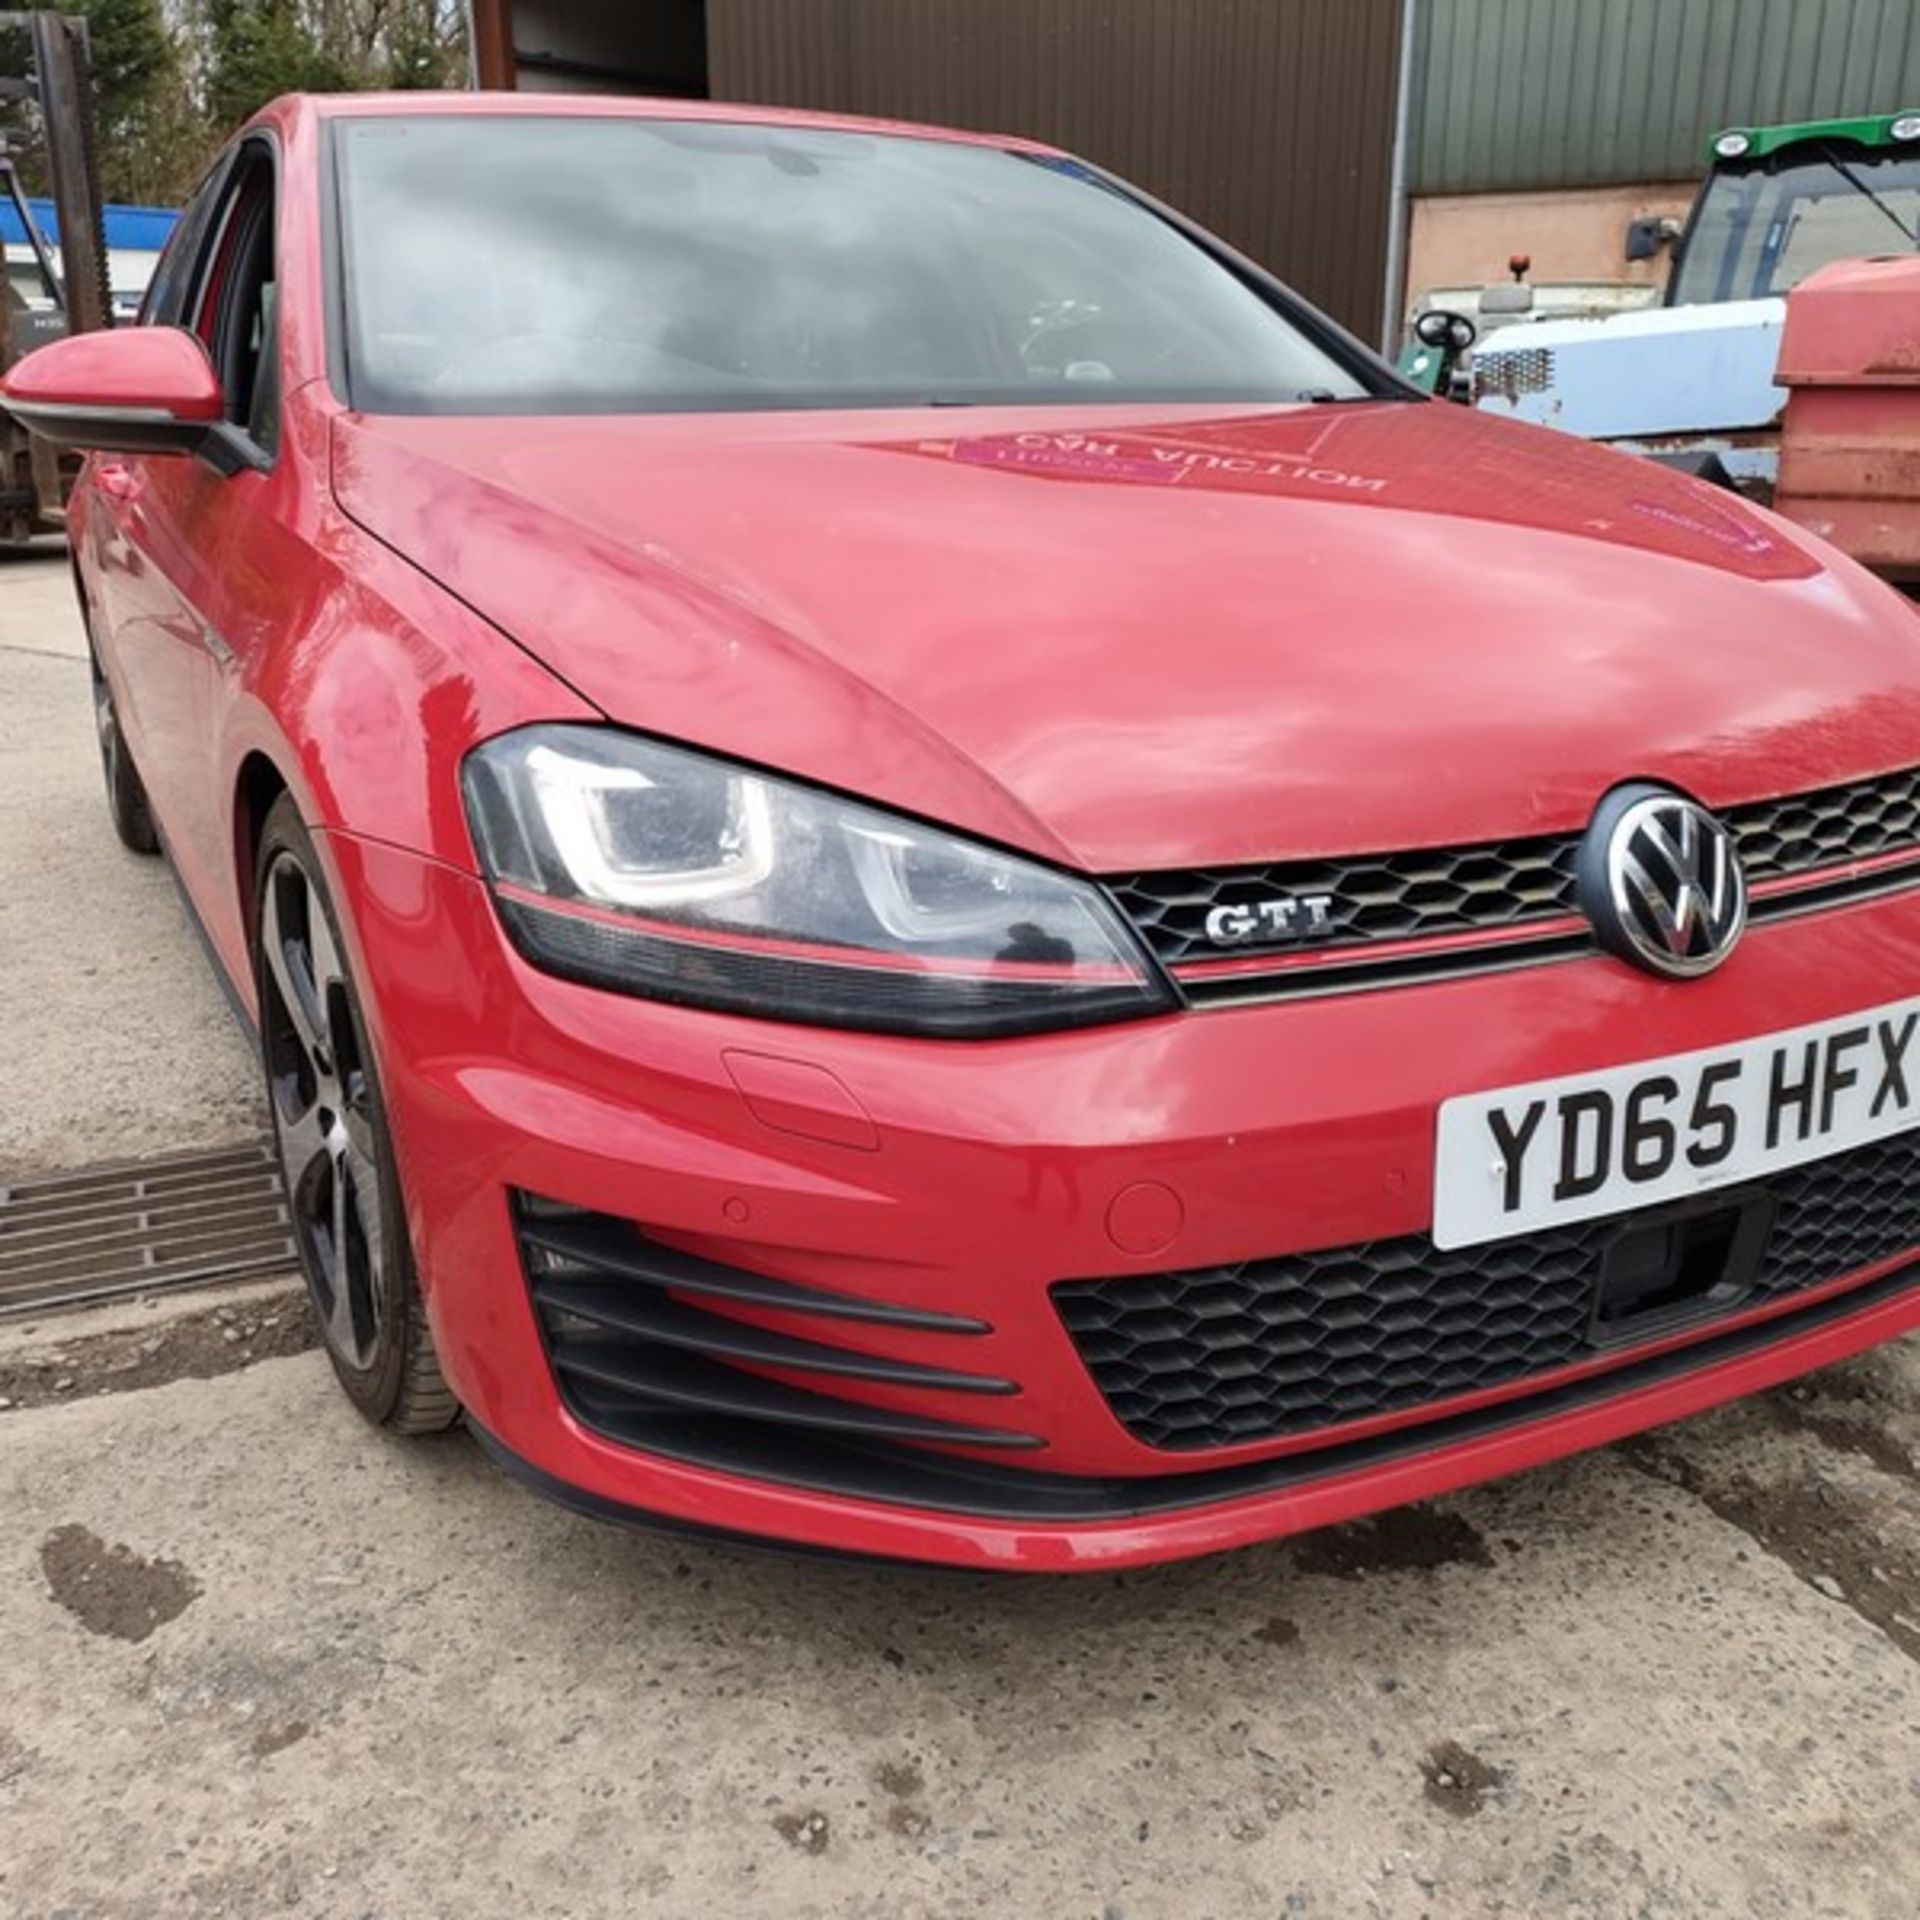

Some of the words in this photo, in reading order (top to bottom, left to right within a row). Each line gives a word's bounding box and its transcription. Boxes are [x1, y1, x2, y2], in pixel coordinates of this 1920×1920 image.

[1205, 895, 1333, 947] GTI
[1611, 795, 1745, 974] VW
[1487, 1058, 1742, 1214] YD65
[1764, 1012, 1919, 1150] HFX
